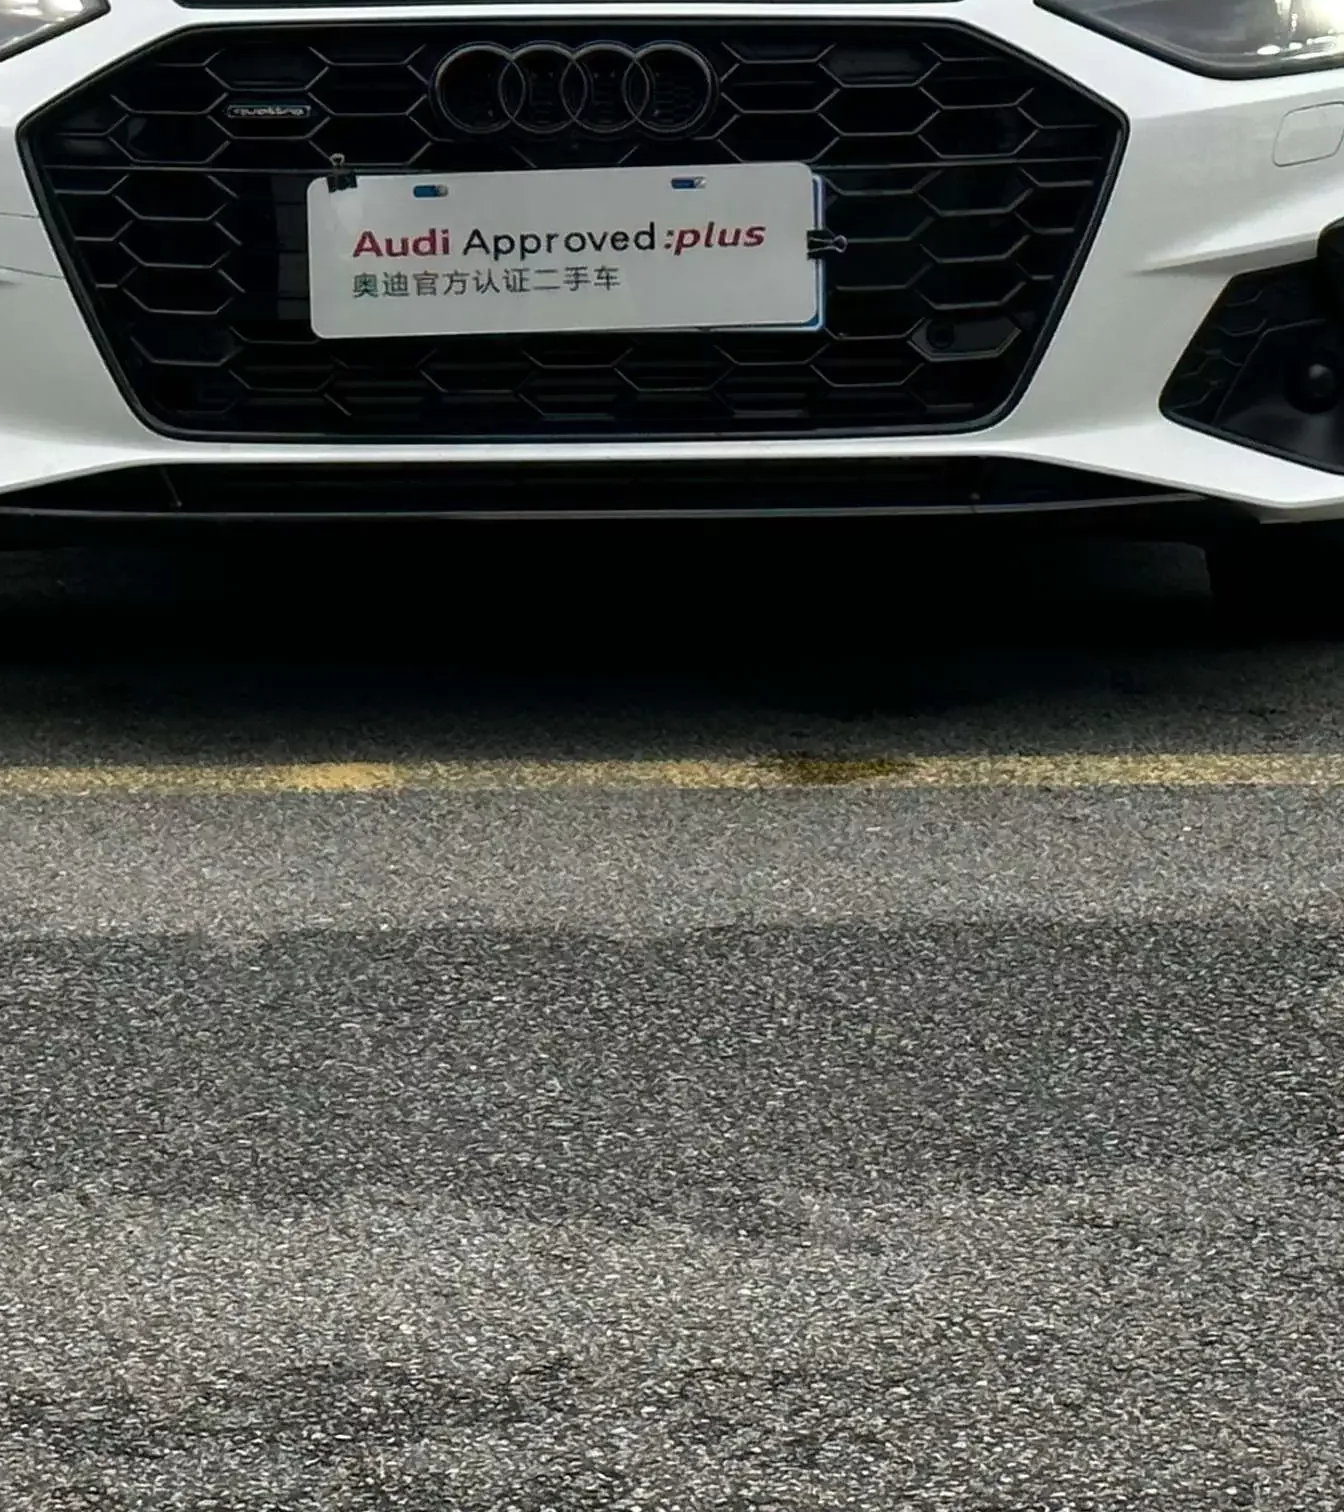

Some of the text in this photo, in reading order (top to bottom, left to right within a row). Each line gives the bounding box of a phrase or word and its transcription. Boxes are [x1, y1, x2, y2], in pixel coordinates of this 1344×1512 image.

[353, 228, 450, 258] Audi
[462, 221, 657, 262] Approved
[353, 265, 620, 299] 奥迪官方认证二手车
